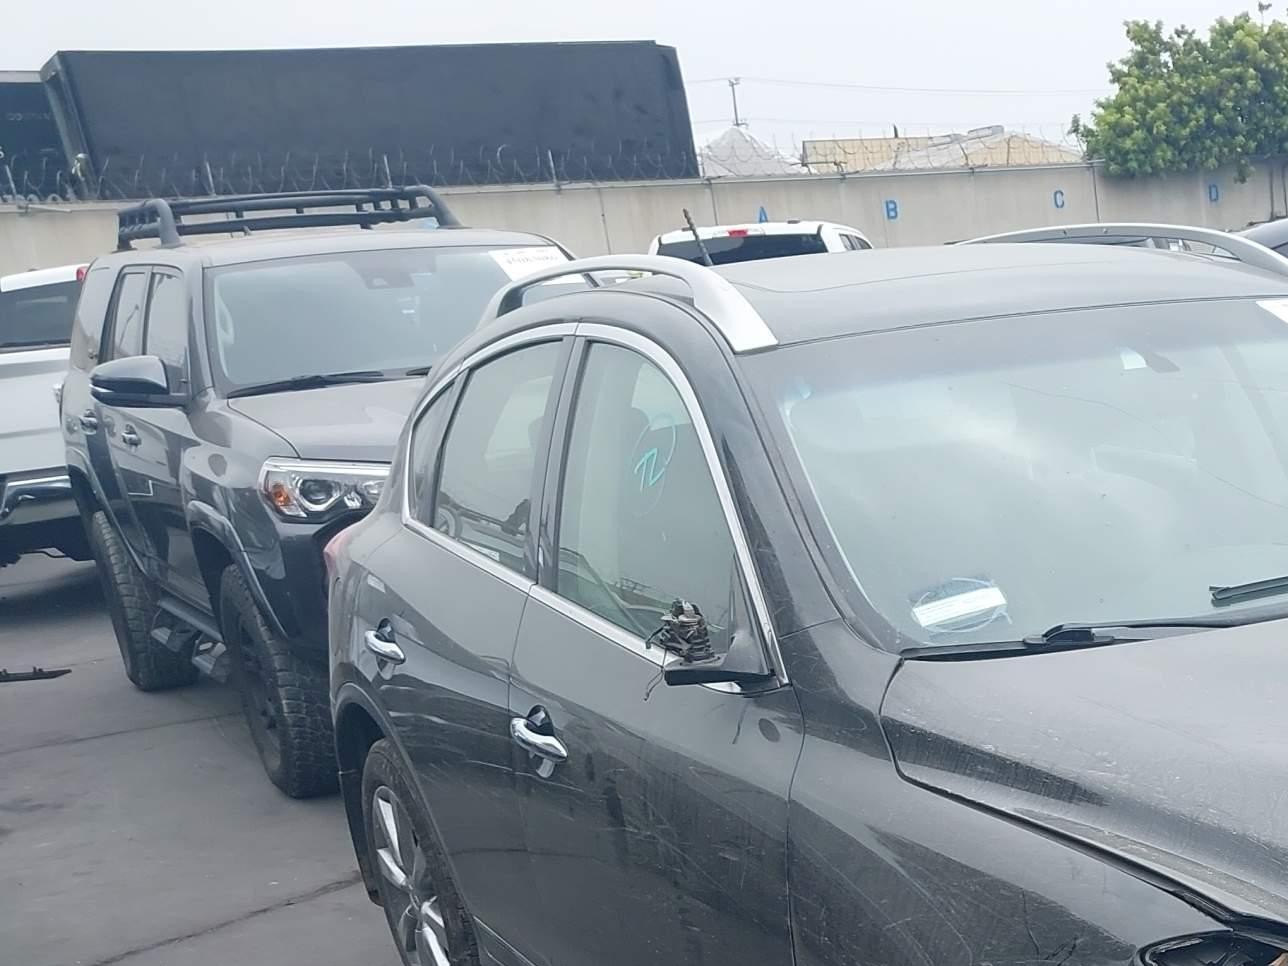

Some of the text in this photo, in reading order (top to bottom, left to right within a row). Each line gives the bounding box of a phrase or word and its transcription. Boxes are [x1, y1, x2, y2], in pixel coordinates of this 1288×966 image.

[1053, 190, 1065, 209] C
[1208, 183, 1219, 202] D
[758, 206, 768, 224] A
[885, 199, 898, 220] B
